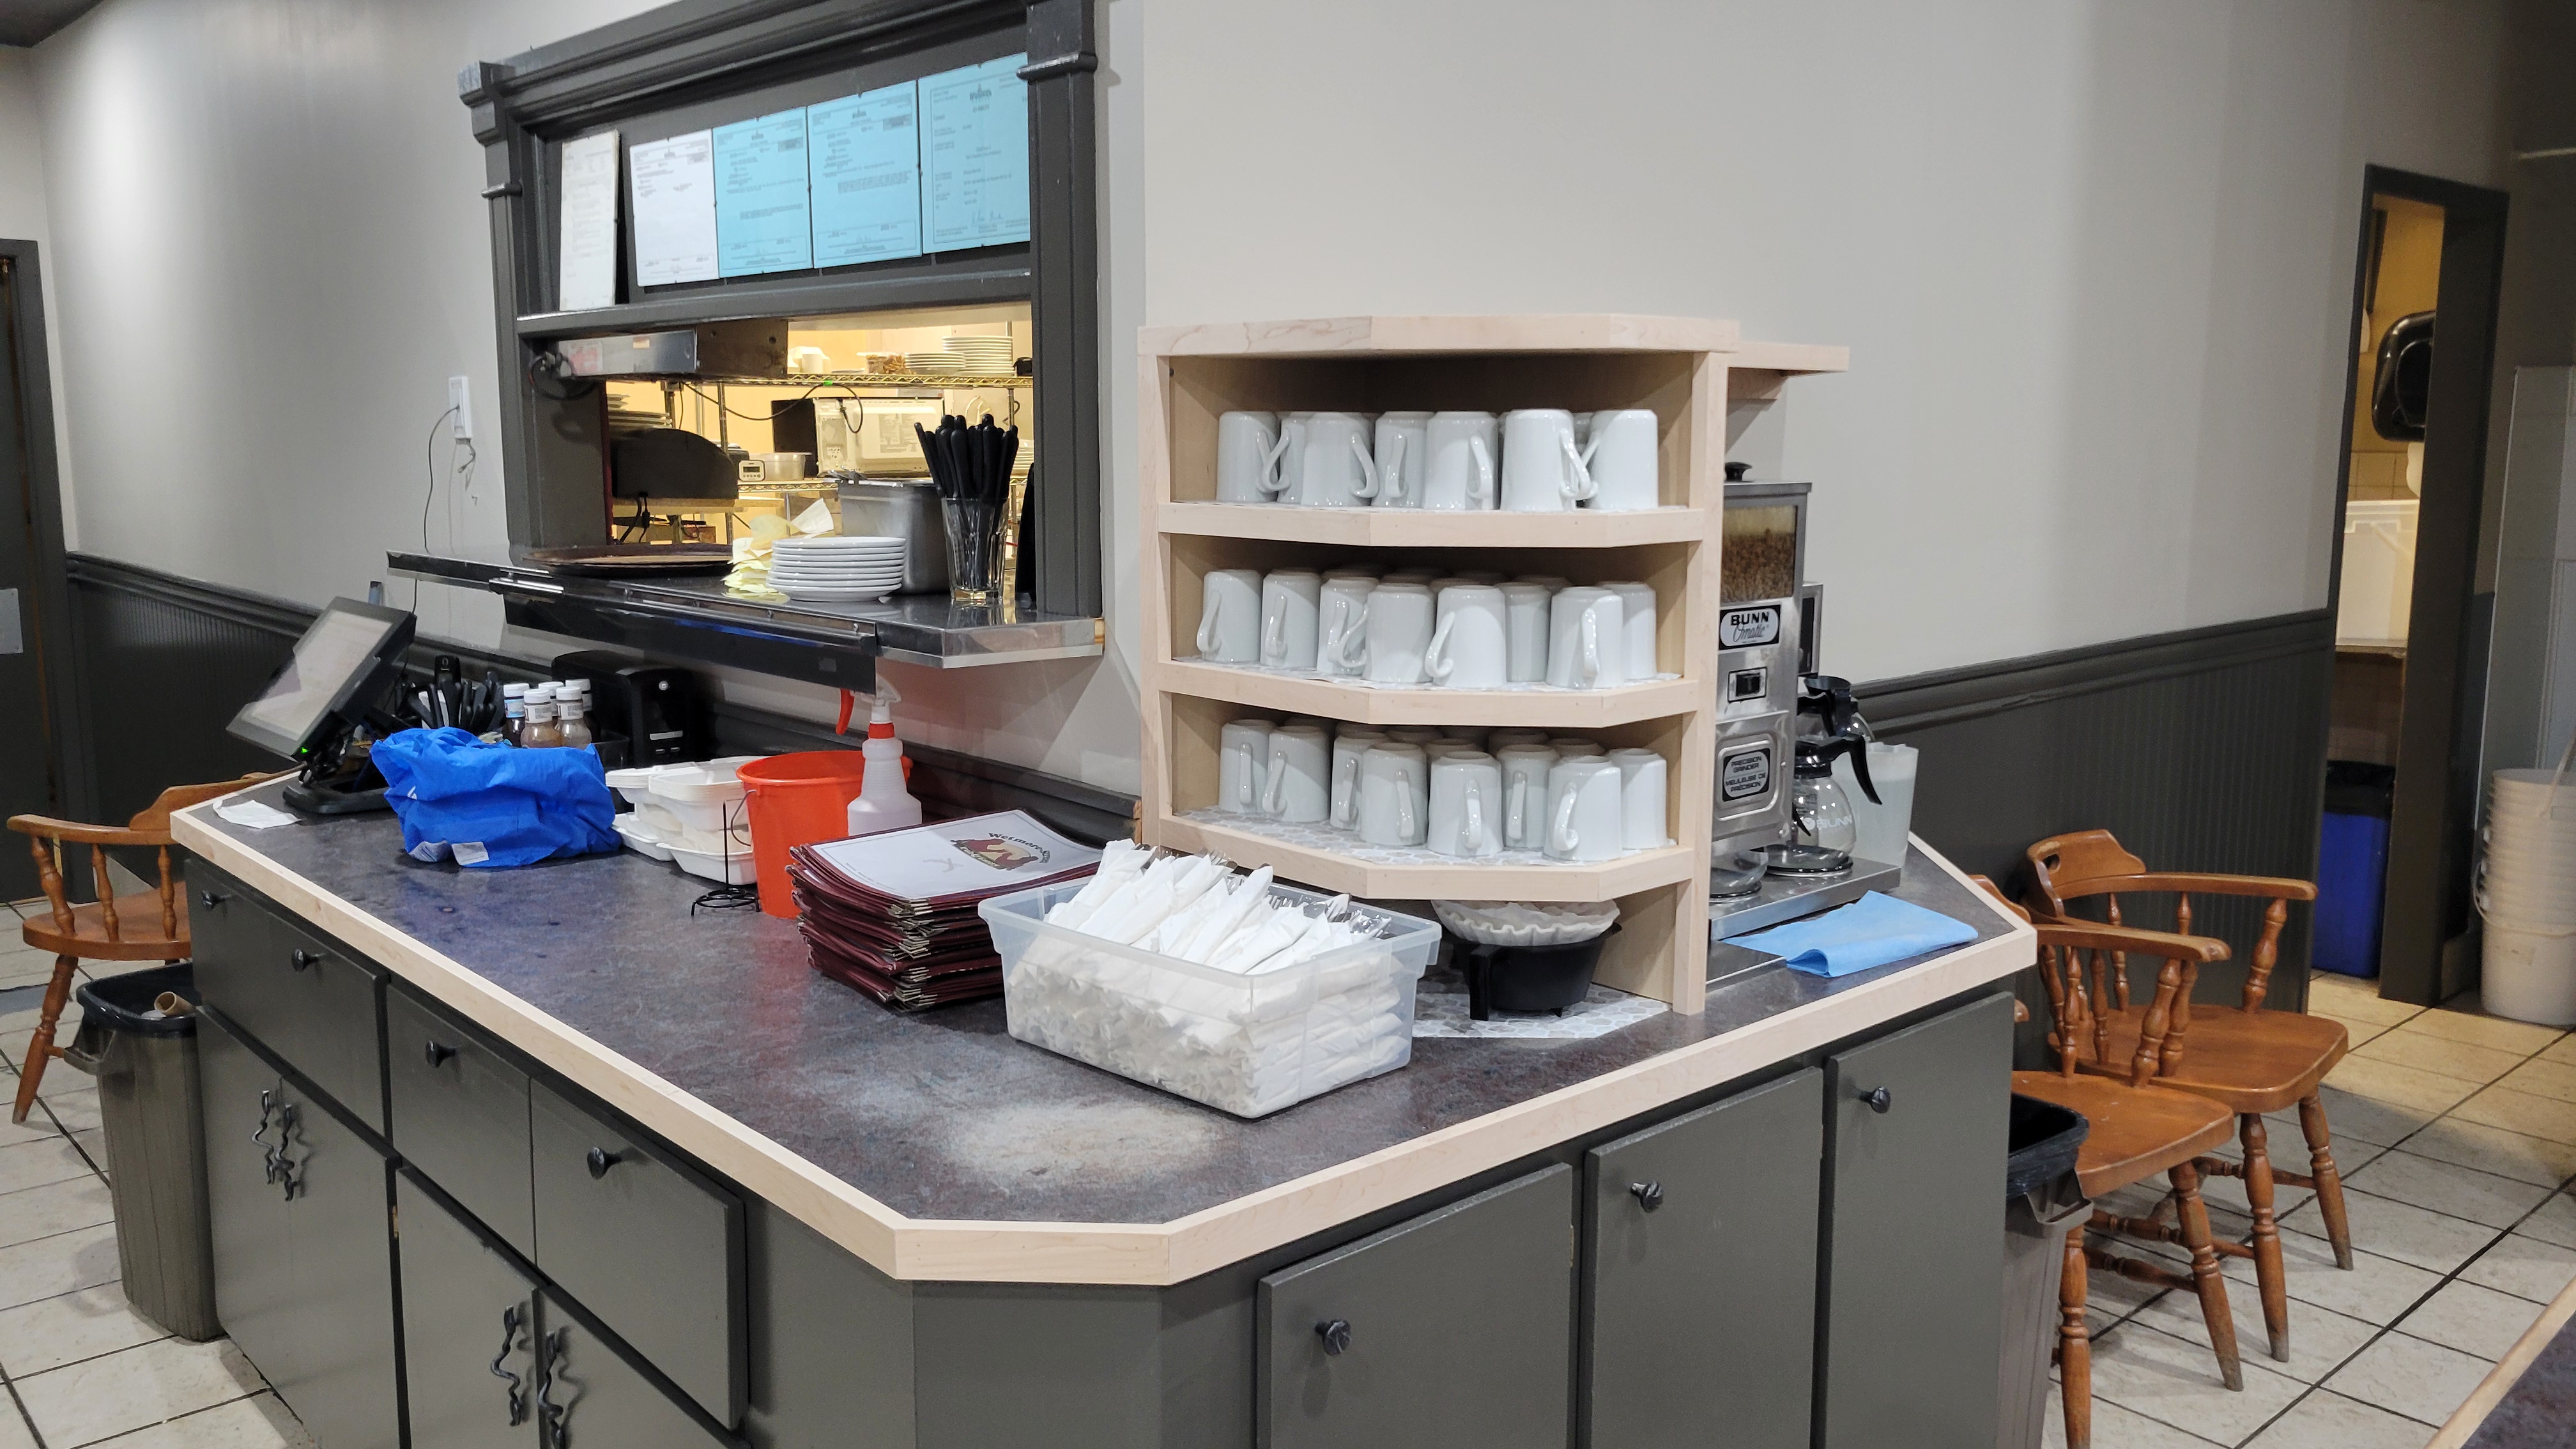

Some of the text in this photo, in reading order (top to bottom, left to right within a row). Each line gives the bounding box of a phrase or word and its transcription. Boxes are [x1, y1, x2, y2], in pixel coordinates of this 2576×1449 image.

[1731, 611, 1770, 626] BUNN
[1731, 756, 1762, 767] PRECISION
[1733, 762, 1759, 773] GRINDER
[1816, 814, 1853, 828] BUNN
